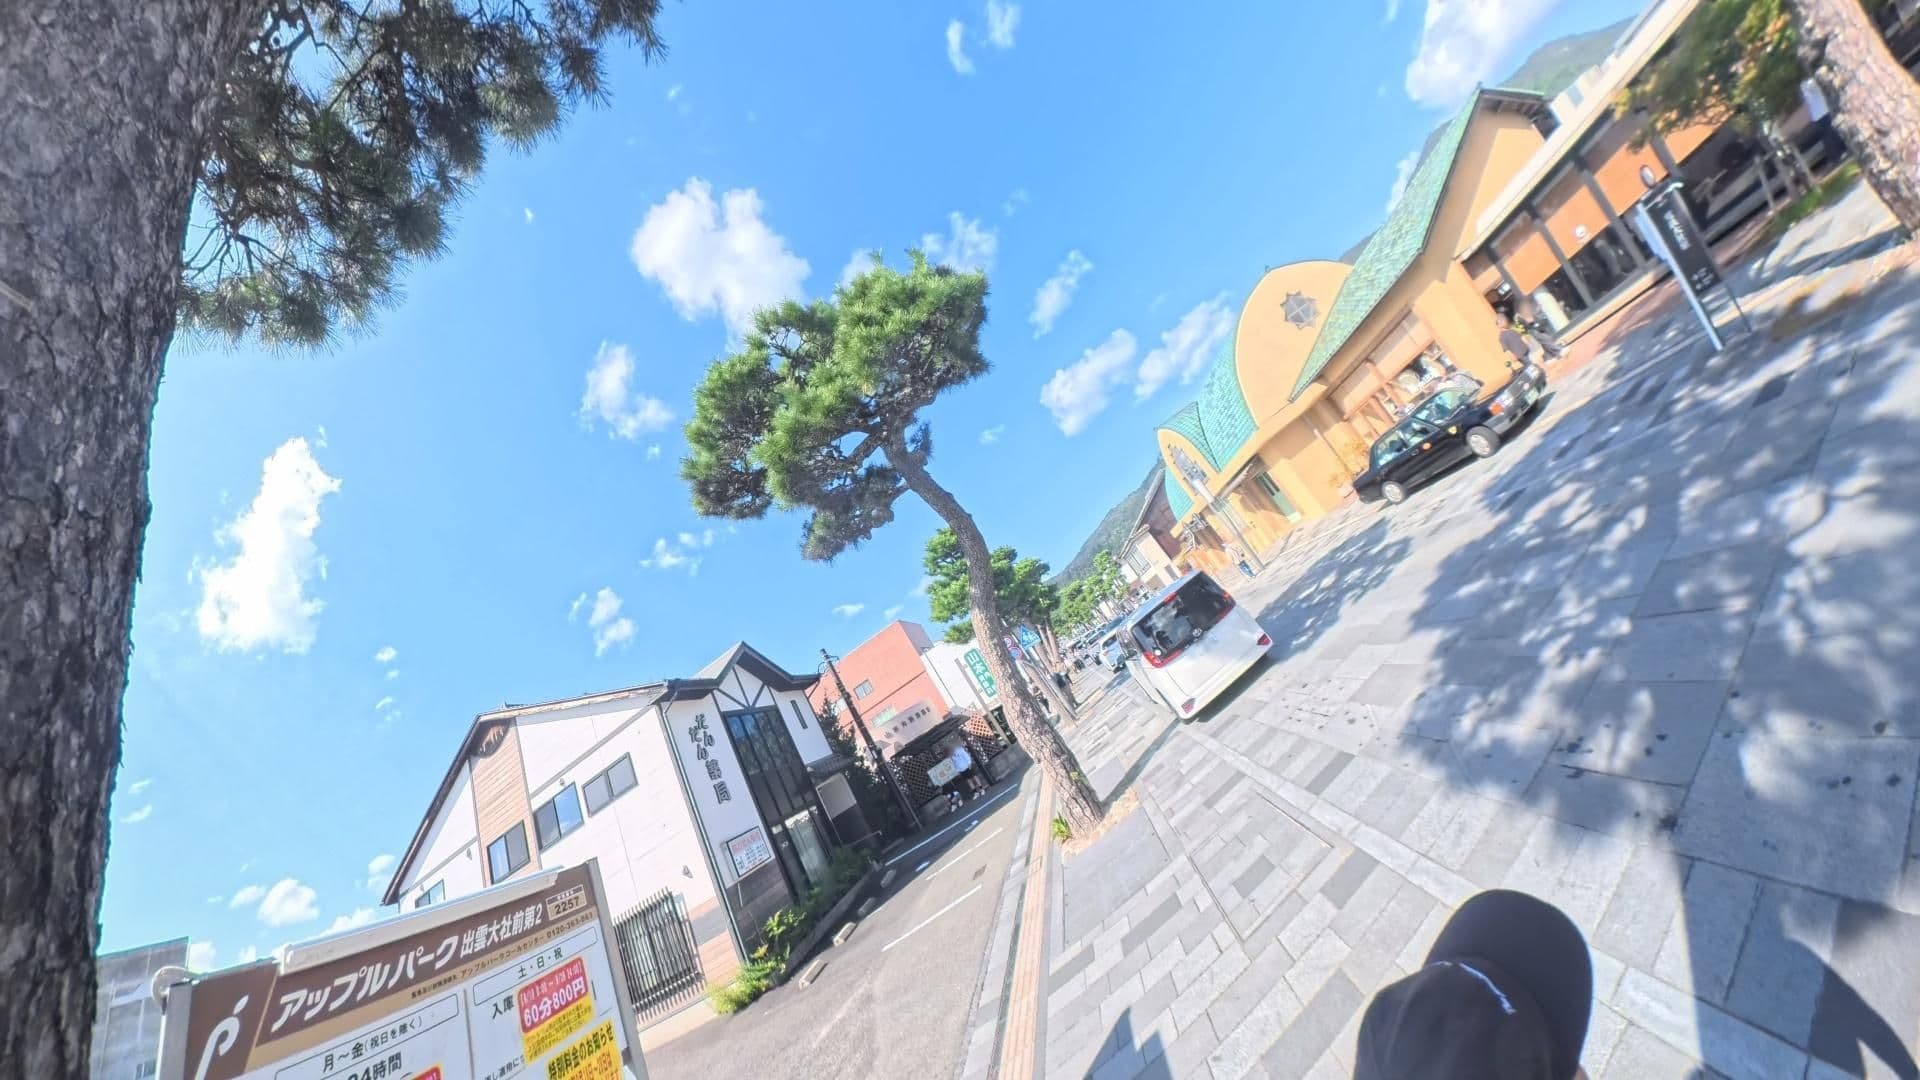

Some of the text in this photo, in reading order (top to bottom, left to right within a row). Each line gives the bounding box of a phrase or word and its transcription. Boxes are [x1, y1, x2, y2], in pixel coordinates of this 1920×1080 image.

[554, 896, 580, 915] 2257
[270, 935, 459, 1033] アップルパーク
[460, 902, 543, 959] 出雲大社前第2
[517, 947, 563, 980] 土・日・祝
[524, 976, 585, 1027] 60分800円
